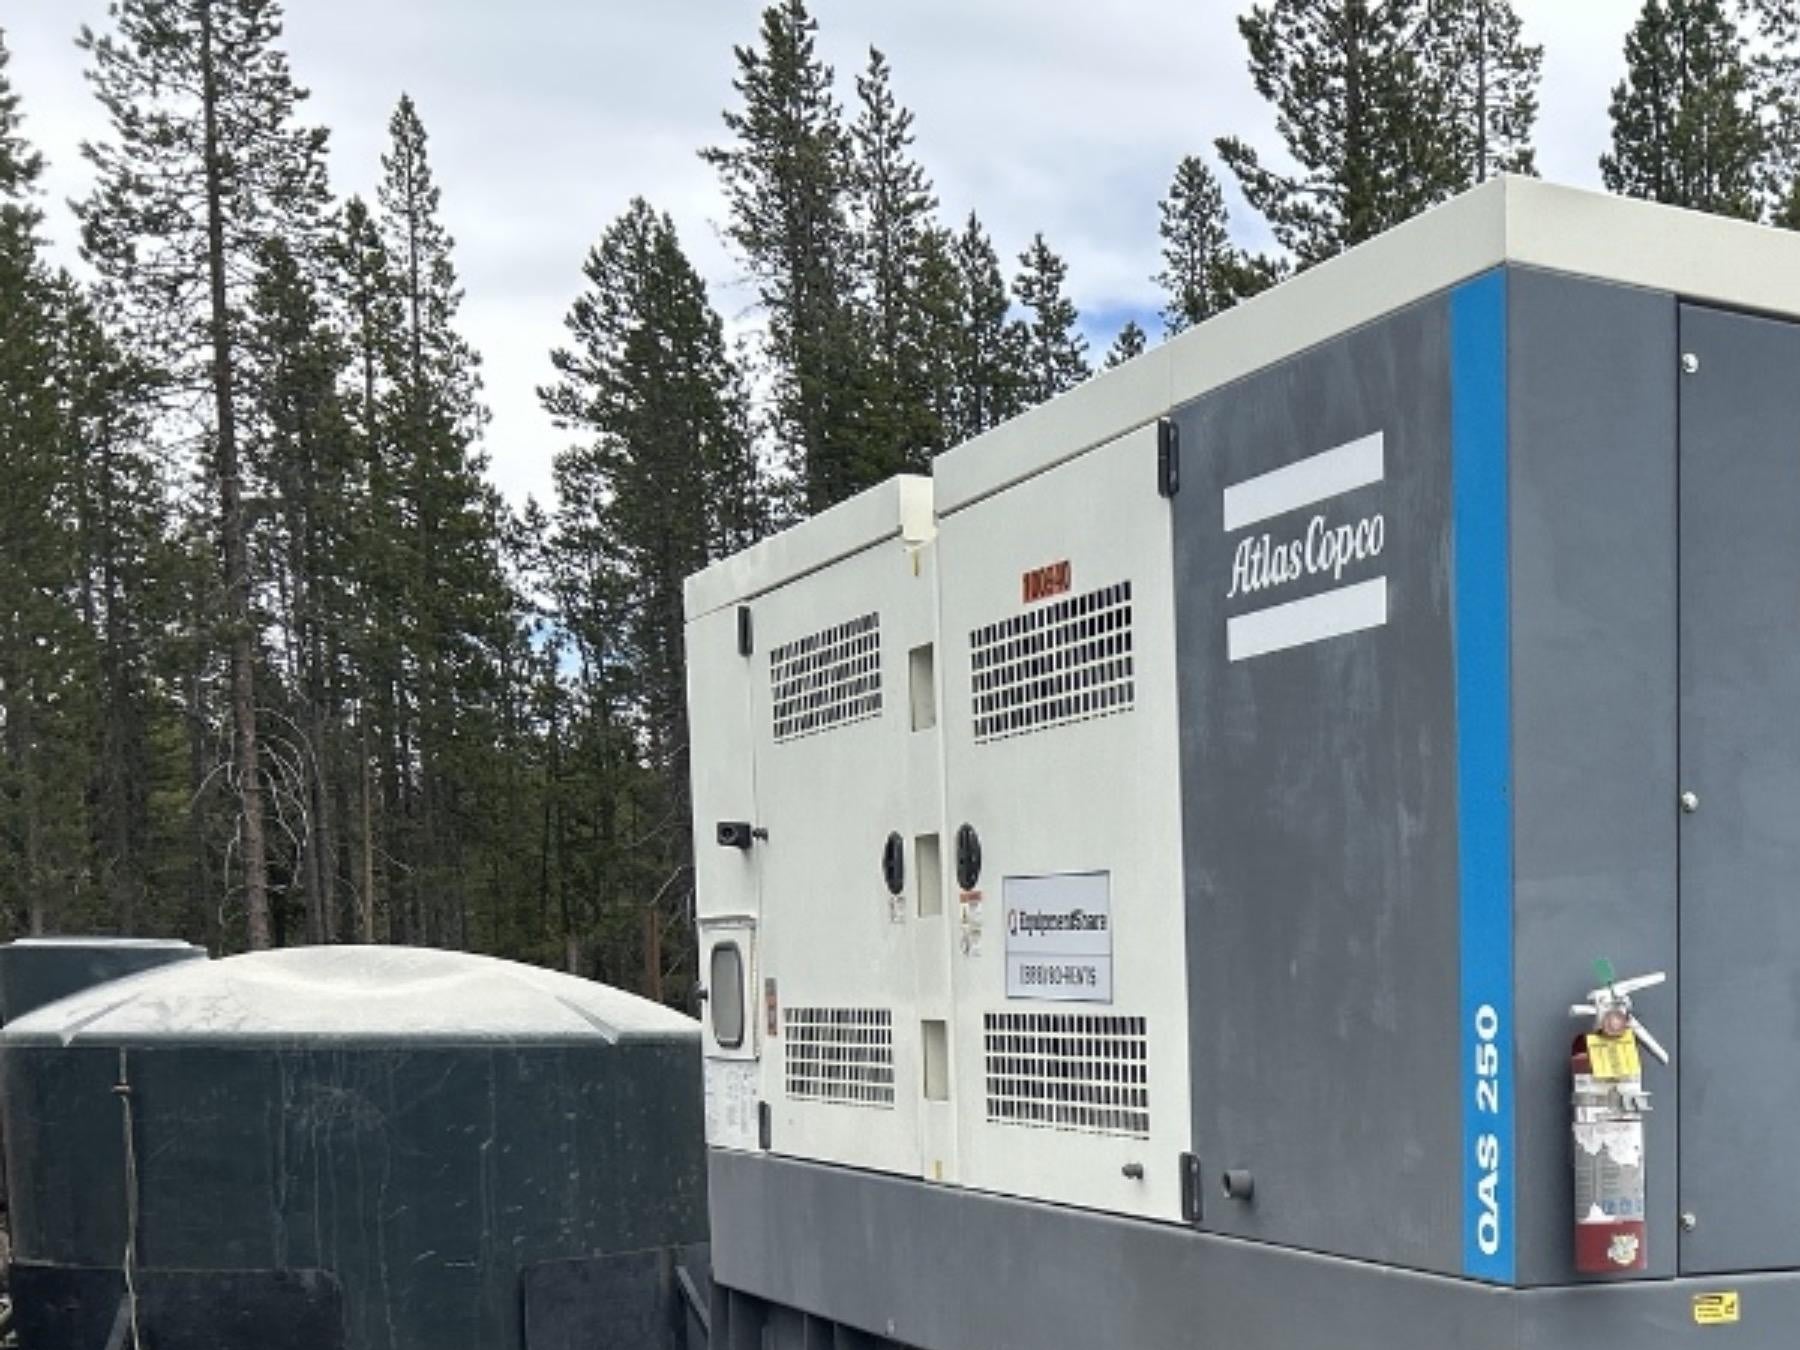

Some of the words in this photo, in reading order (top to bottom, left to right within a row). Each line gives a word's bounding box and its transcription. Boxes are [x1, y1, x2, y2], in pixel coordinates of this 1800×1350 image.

[1226, 533, 1302, 598] Atlas
[1305, 513, 1385, 580] Copco
[1475, 1003, 1499, 1116] 250
